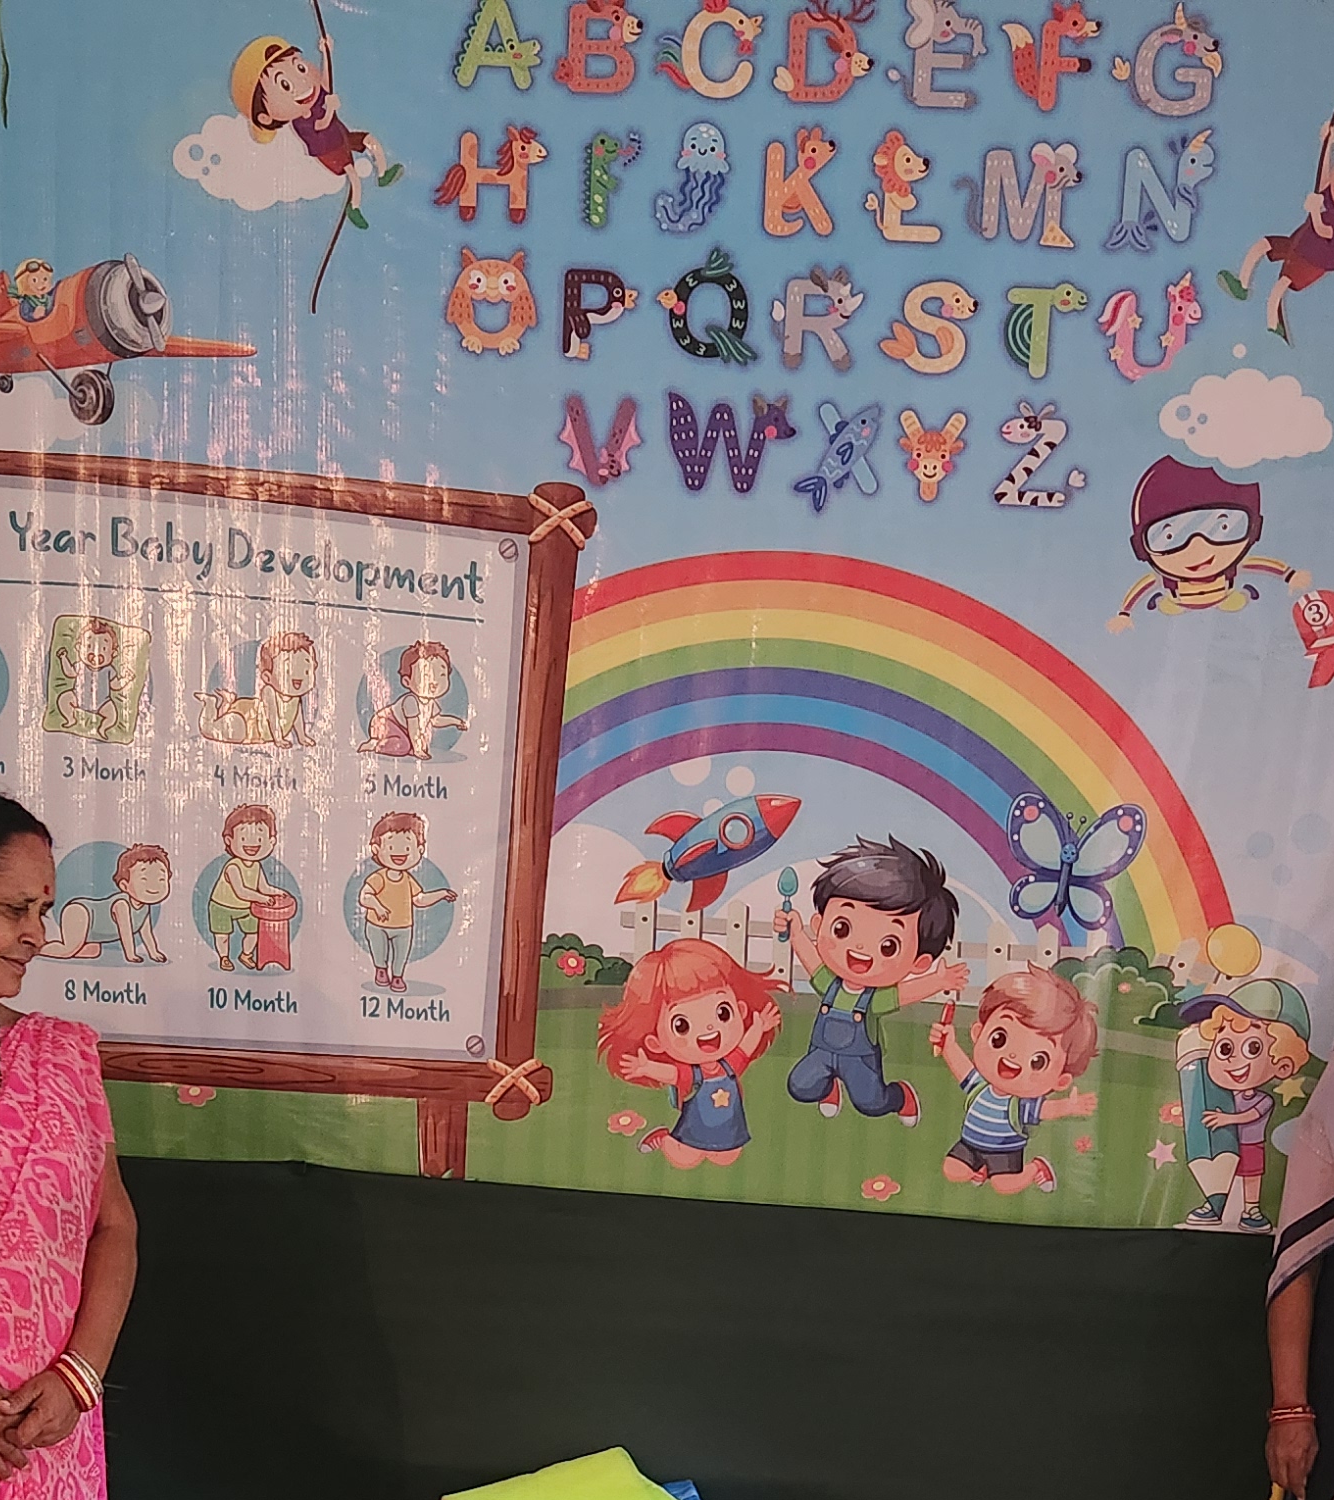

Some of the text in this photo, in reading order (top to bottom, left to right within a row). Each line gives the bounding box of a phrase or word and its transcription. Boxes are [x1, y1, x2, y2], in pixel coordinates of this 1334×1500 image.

[457, 0, 1221, 116] A B C D E F G
[449, 127, 544, 224] H
[655, 121, 731, 233] J
[764, 127, 837, 236] K
[981, 143, 1082, 248] M
[1113, 134, 1208, 250] N
[562, 269, 638, 359] P
[667, 258, 755, 366] Q
[776, 268, 862, 369] R
[886, 280, 978, 375] S
[1005, 281, 1088, 378] T
[1103, 272, 1202, 381] U
[560, 399, 640, 486] V
[669, 393, 791, 493] W
[994, 404, 1071, 509] Z
[9, 511, 95, 556] Year
[110, 516, 218, 583] Baby
[227, 526, 486, 605] Development
[1308, 603, 1324, 623] 3
[62, 757, 147, 782] 3 Month
[213, 766, 298, 793] 4 Month
[382, 774, 449, 800] Month
[63, 980, 147, 1005] 8 Month
[207, 987, 299, 1014] 10 Month
[359, 996, 451, 1023] 12 Month
